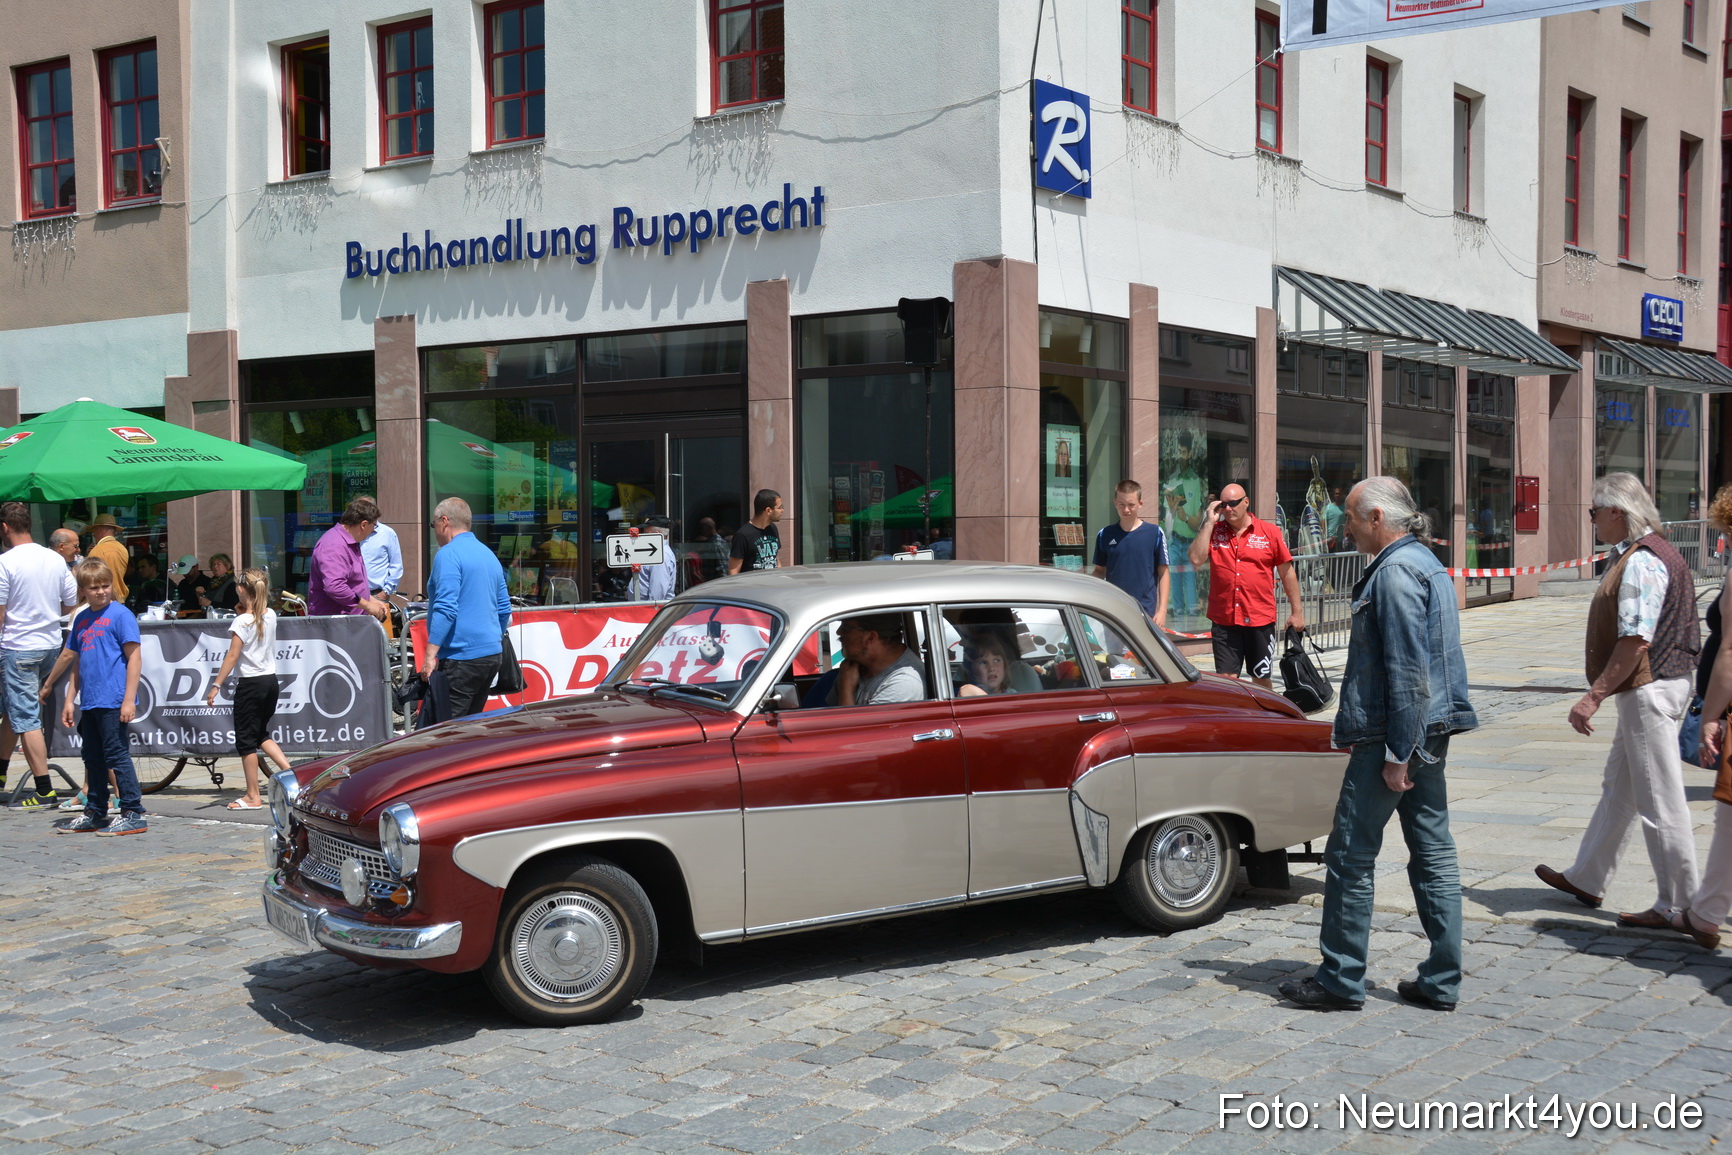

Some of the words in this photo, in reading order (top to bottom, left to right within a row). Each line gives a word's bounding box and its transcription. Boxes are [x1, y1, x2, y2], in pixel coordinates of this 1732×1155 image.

[1395, 3, 1429, 12] Neumarkter
[346, 218, 596, 278] Buchhandlung
[613, 183, 826, 256] Rupprecht
[1560, 308, 1590, 321] Klostergasse
[1590, 313, 1594, 322] 2
[1650, 298, 1683, 327] CECIL
[1607, 400, 1634, 422] CECIL
[1665, 408, 1690, 427] CECIL
[106, 453, 224, 464] Lammsbräu
[113, 447, 197, 455] Neumarkter
[346, 470, 372, 478] GARTEN
[167, 667, 299, 702] Diez
